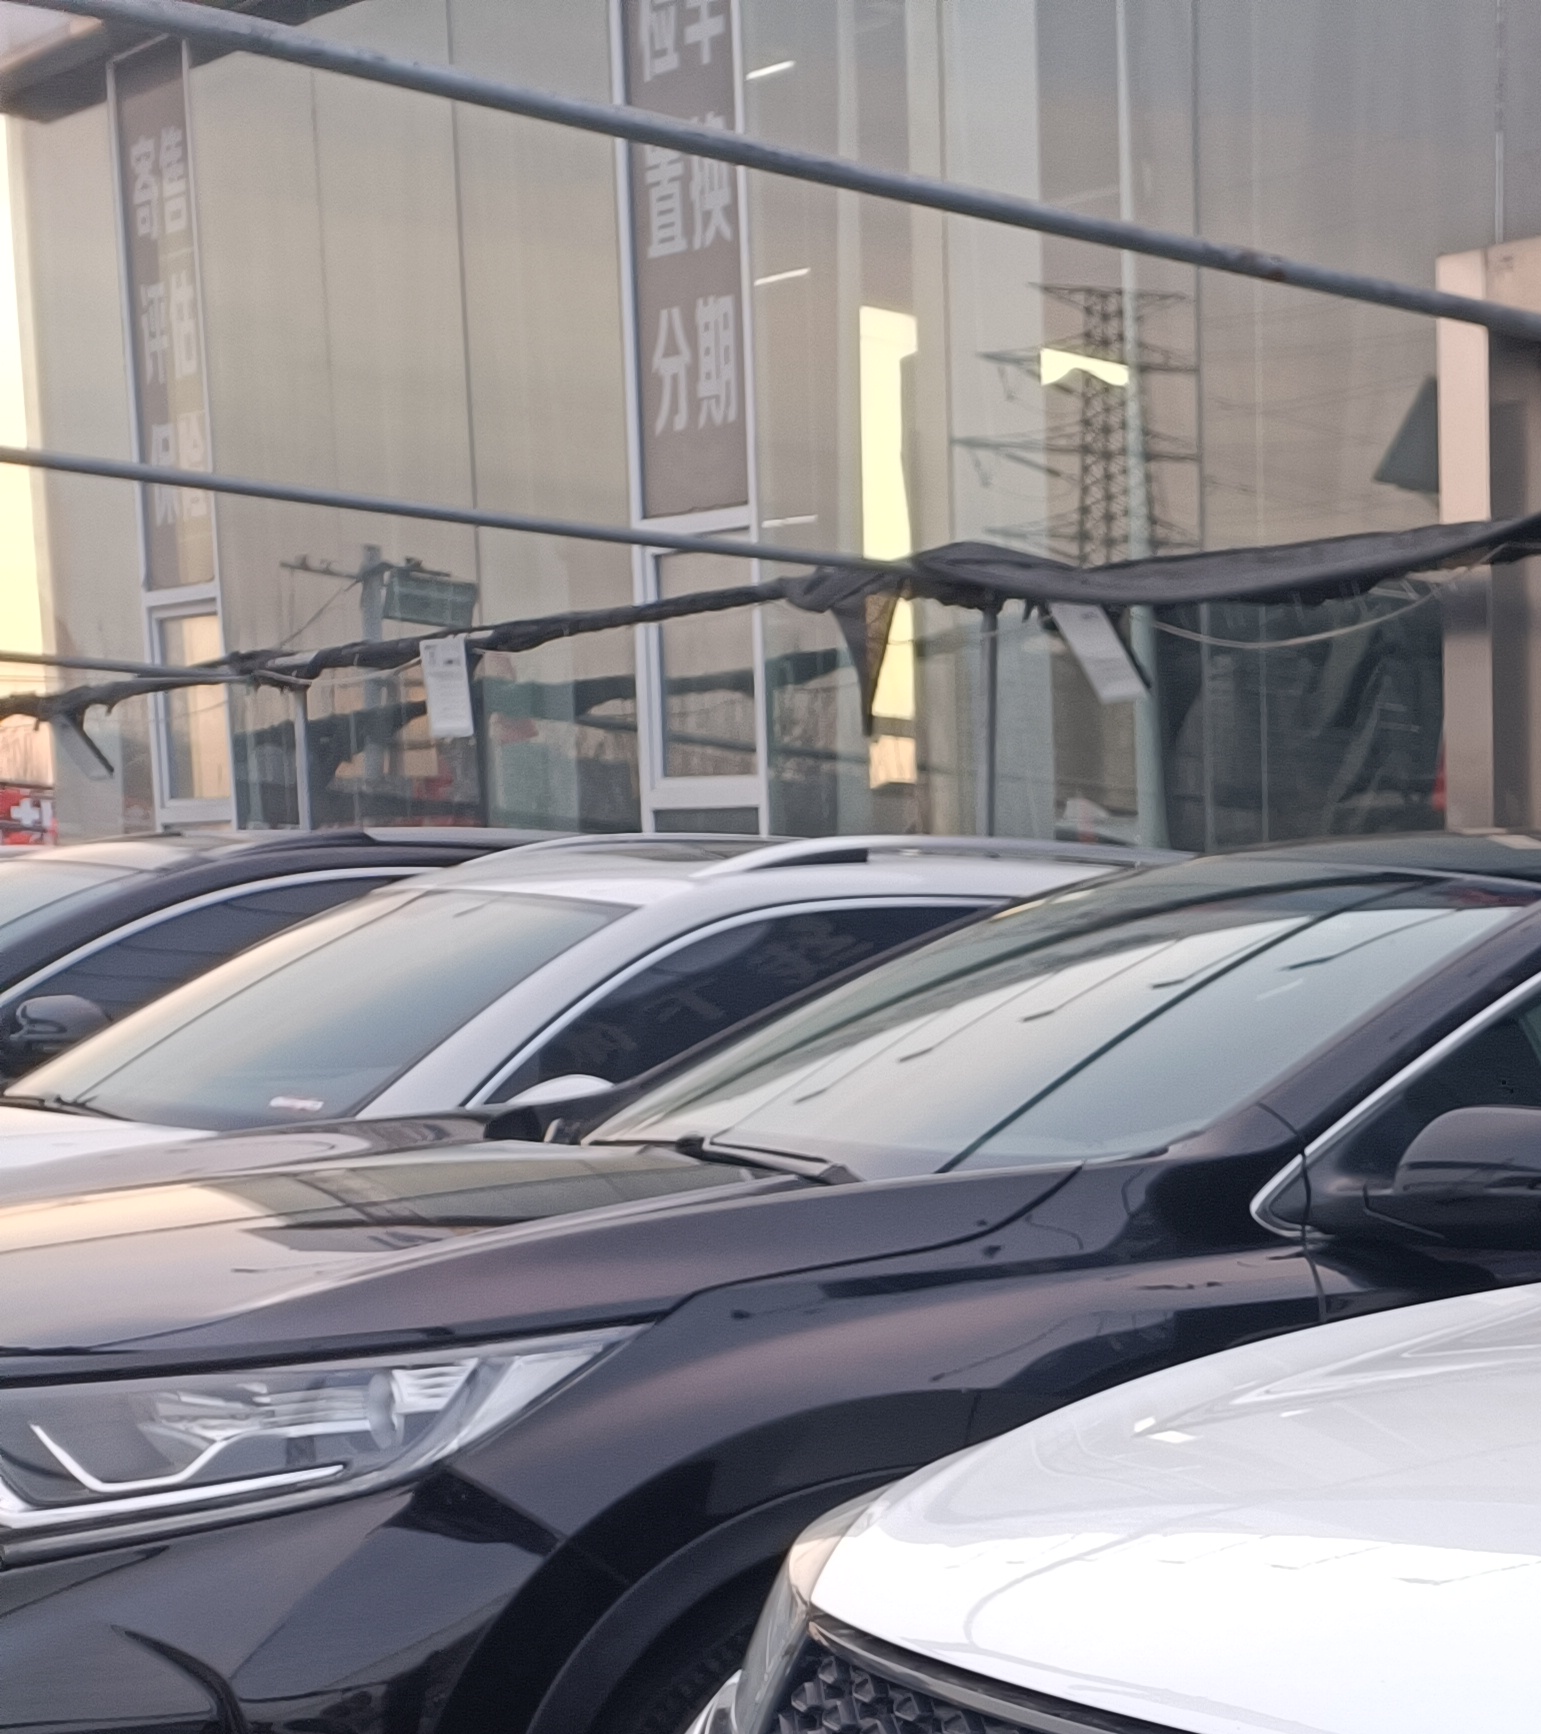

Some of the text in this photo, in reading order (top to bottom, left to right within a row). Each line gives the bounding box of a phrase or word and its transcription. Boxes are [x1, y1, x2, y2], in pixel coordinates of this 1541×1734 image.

[129, 125, 188, 240] 寄售
[645, 111, 733, 259] 置换
[140, 269, 198, 385] 评估
[653, 294, 738, 437] 分期
